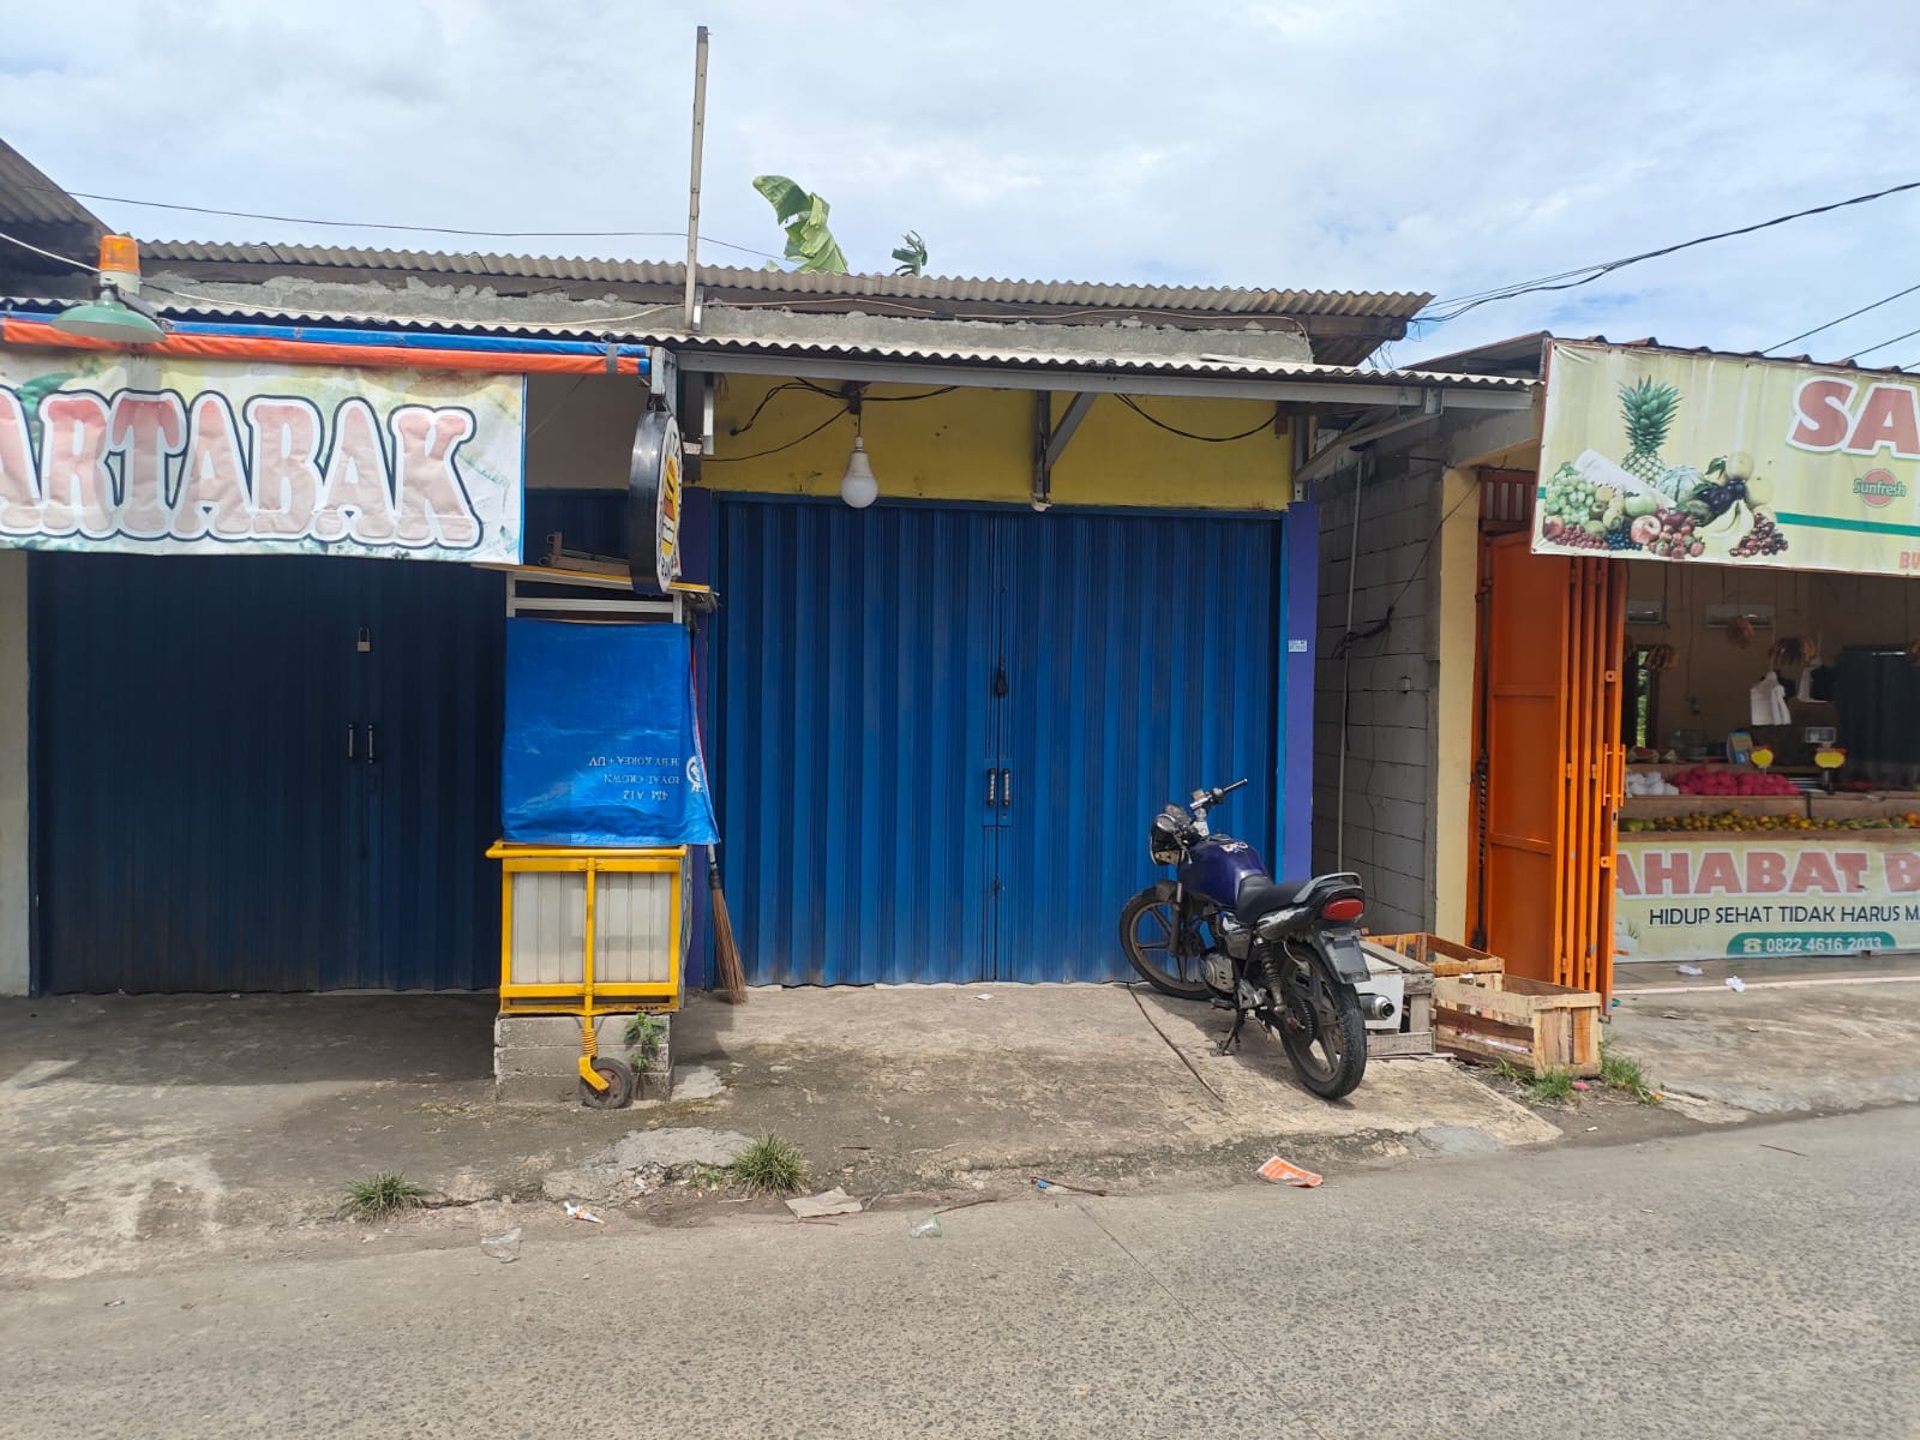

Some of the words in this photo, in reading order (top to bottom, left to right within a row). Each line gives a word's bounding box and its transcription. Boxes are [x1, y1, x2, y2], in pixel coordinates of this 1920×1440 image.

[1853, 478, 1906, 497] Sunfresh
[588, 756, 606, 766] UV
[617, 756, 653, 767] KOREA
[1649, 907, 1711, 925] HIDUP
[1715, 905, 1773, 924] SEHAT
[1779, 905, 1836, 923] TIDAK
[1841, 905, 1900, 922] HARUS
[1766, 938, 1801, 952] 0822
[1806, 937, 1842, 951] 4616
